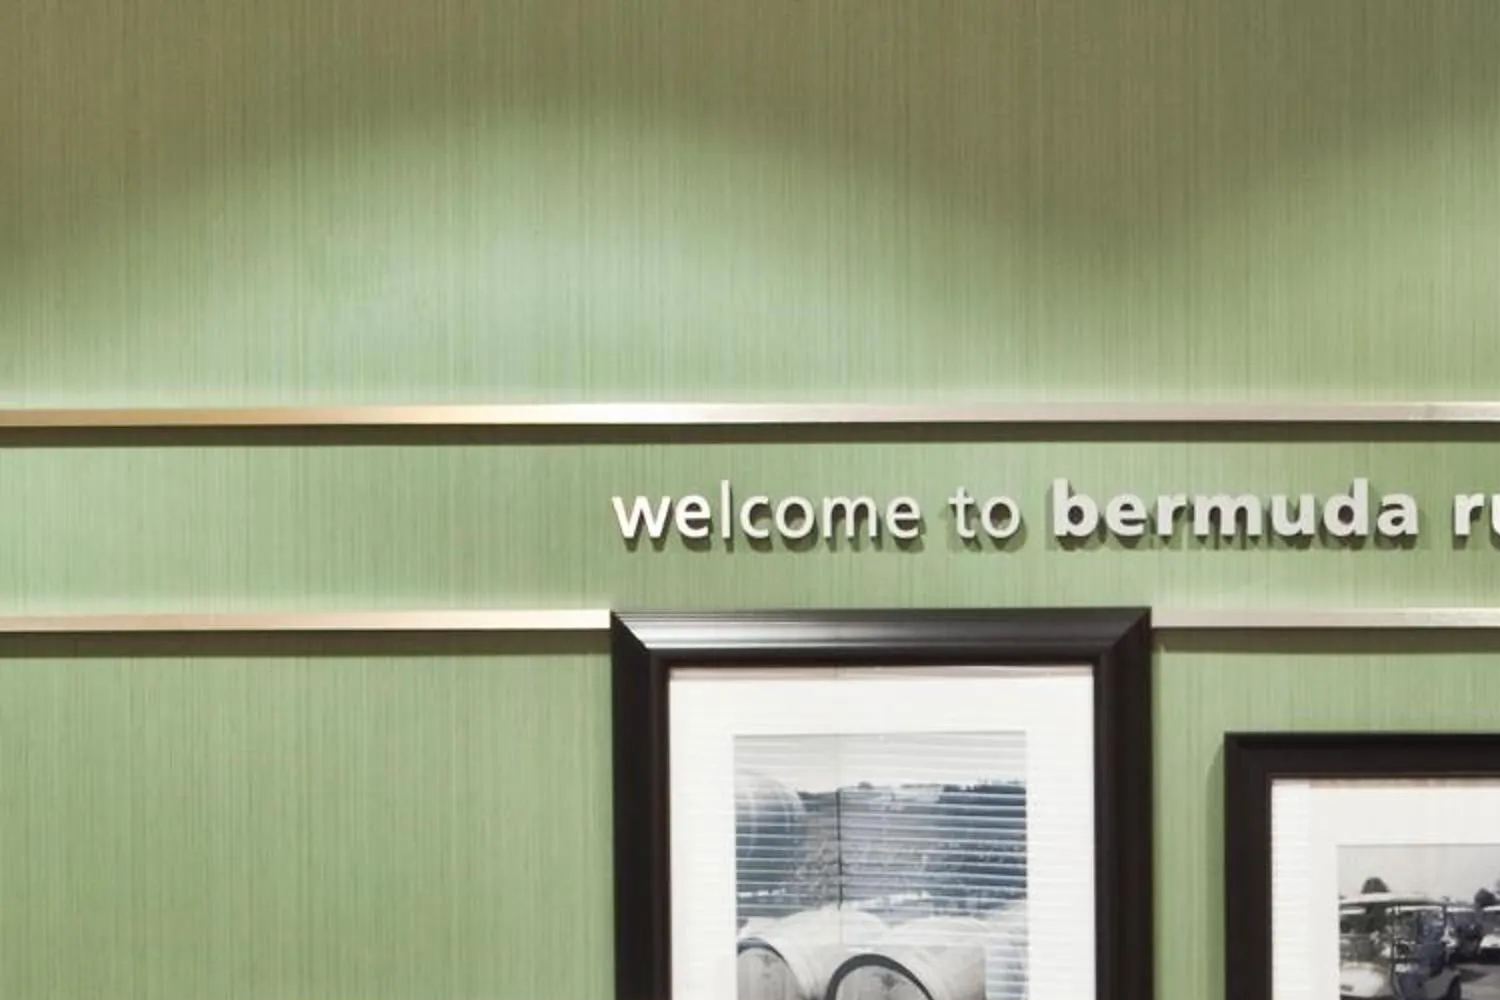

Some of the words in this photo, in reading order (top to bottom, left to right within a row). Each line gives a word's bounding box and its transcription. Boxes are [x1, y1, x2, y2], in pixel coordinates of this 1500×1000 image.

[612, 479, 922, 541] welcome
[949, 486, 1022, 541] to
[1052, 478, 1419, 538] bermuda
